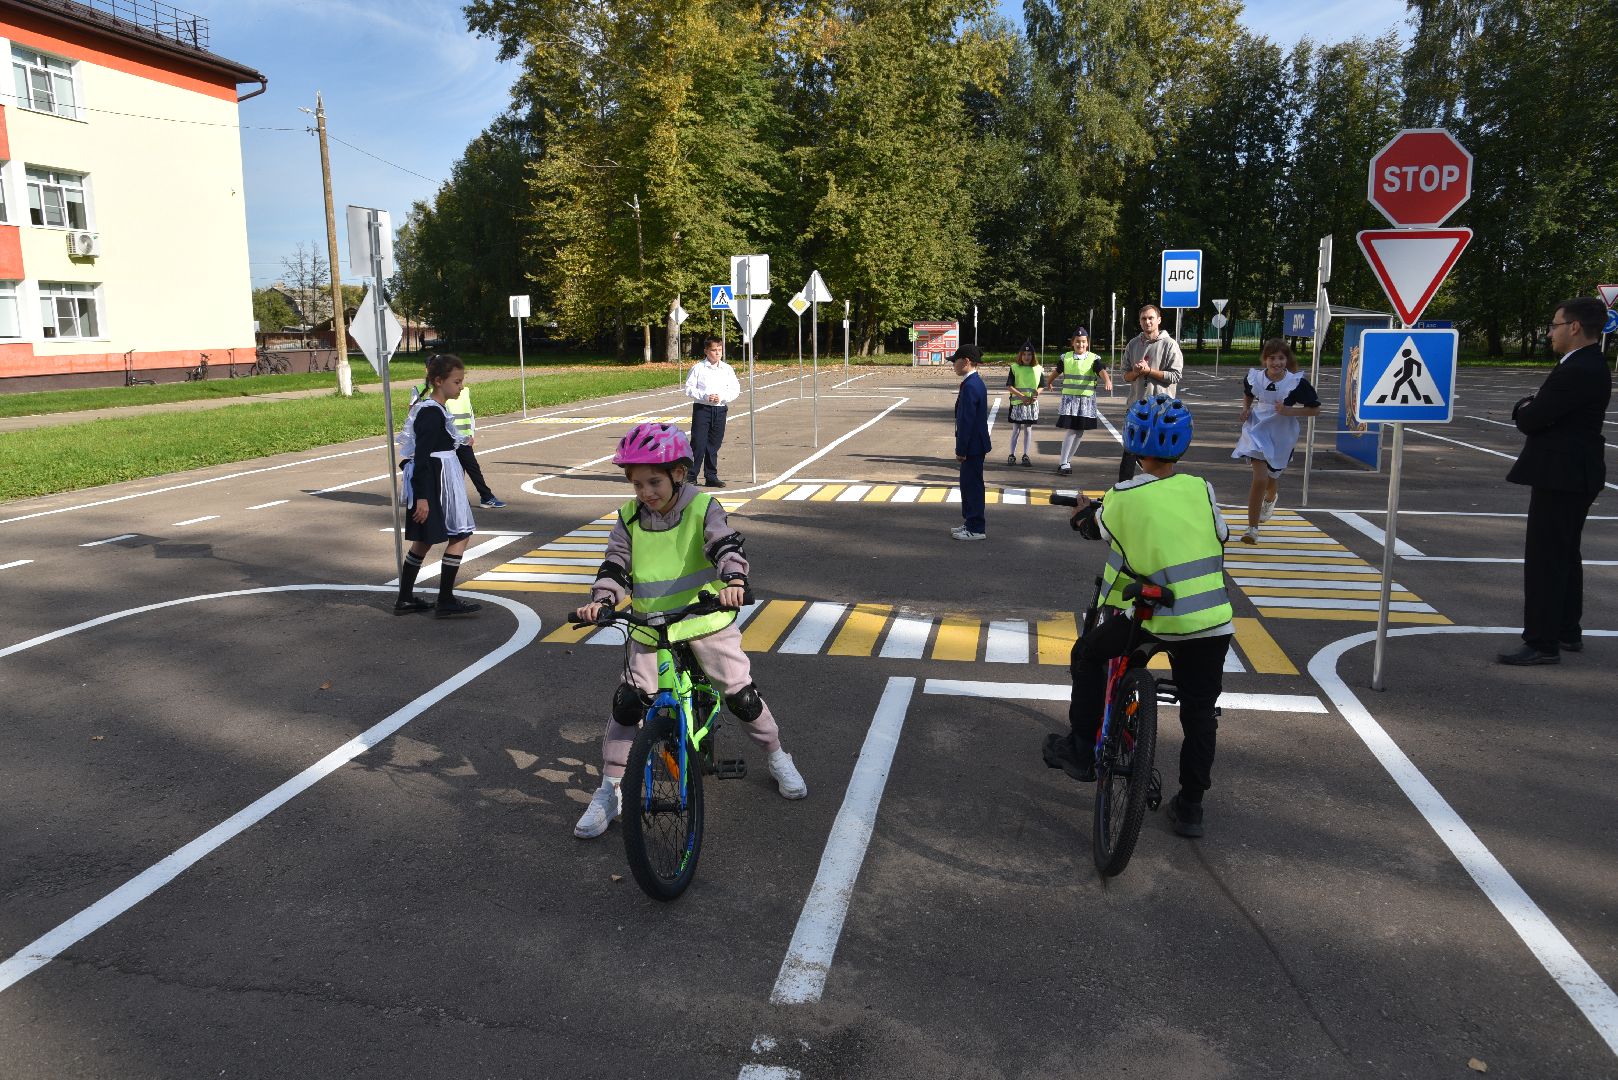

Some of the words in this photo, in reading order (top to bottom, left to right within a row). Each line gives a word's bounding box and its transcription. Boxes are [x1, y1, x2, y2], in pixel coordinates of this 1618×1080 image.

[1383, 165, 1459, 192] STOP
[1168, 270, 1194, 281] ДПС
[1293, 314, 1304, 332] ДПС
